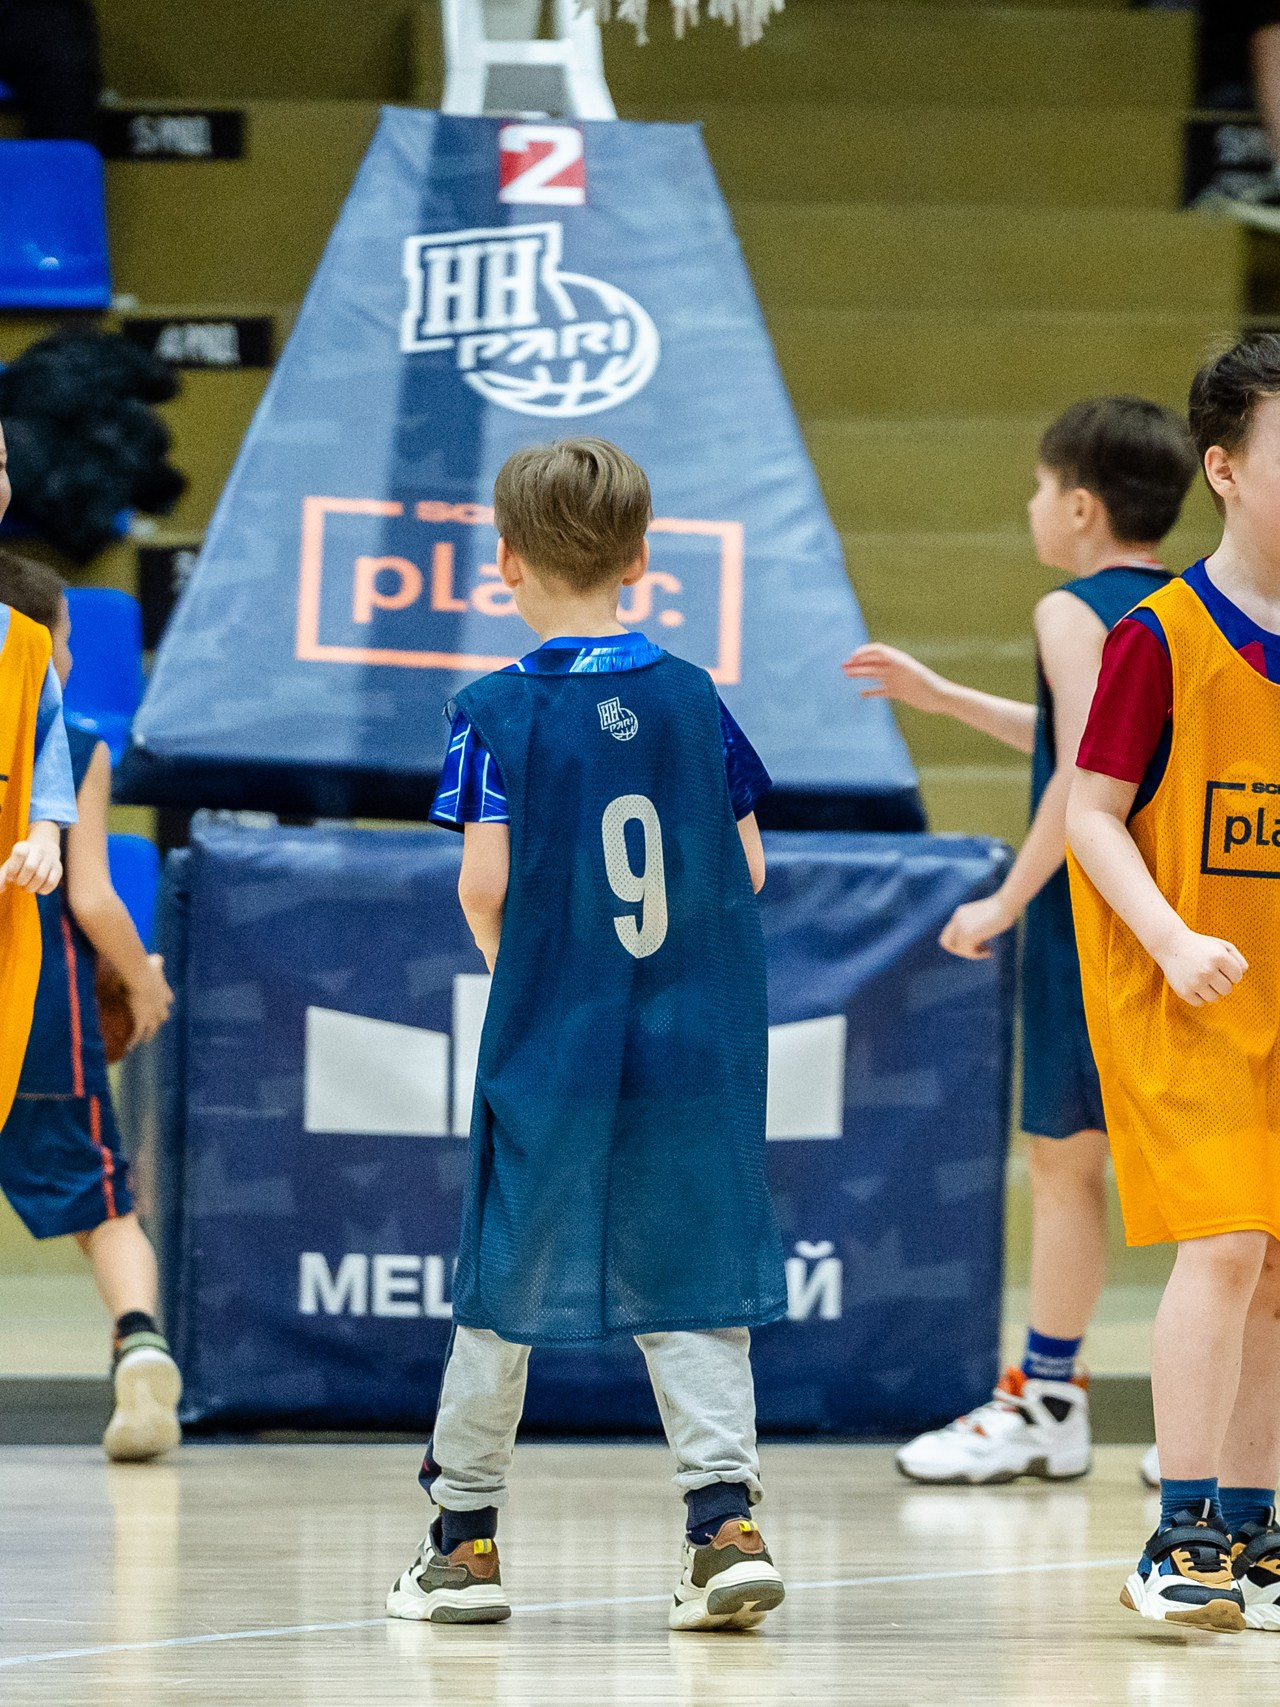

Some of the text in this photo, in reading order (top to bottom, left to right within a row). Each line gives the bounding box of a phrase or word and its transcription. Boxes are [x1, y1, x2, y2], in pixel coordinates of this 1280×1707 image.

[499, 124, 586, 206] 2
[458, 318, 632, 370] PARI
[353, 541, 685, 627] plas.
[610, 716, 634, 733] PARI
[602, 794, 668, 958] 9
